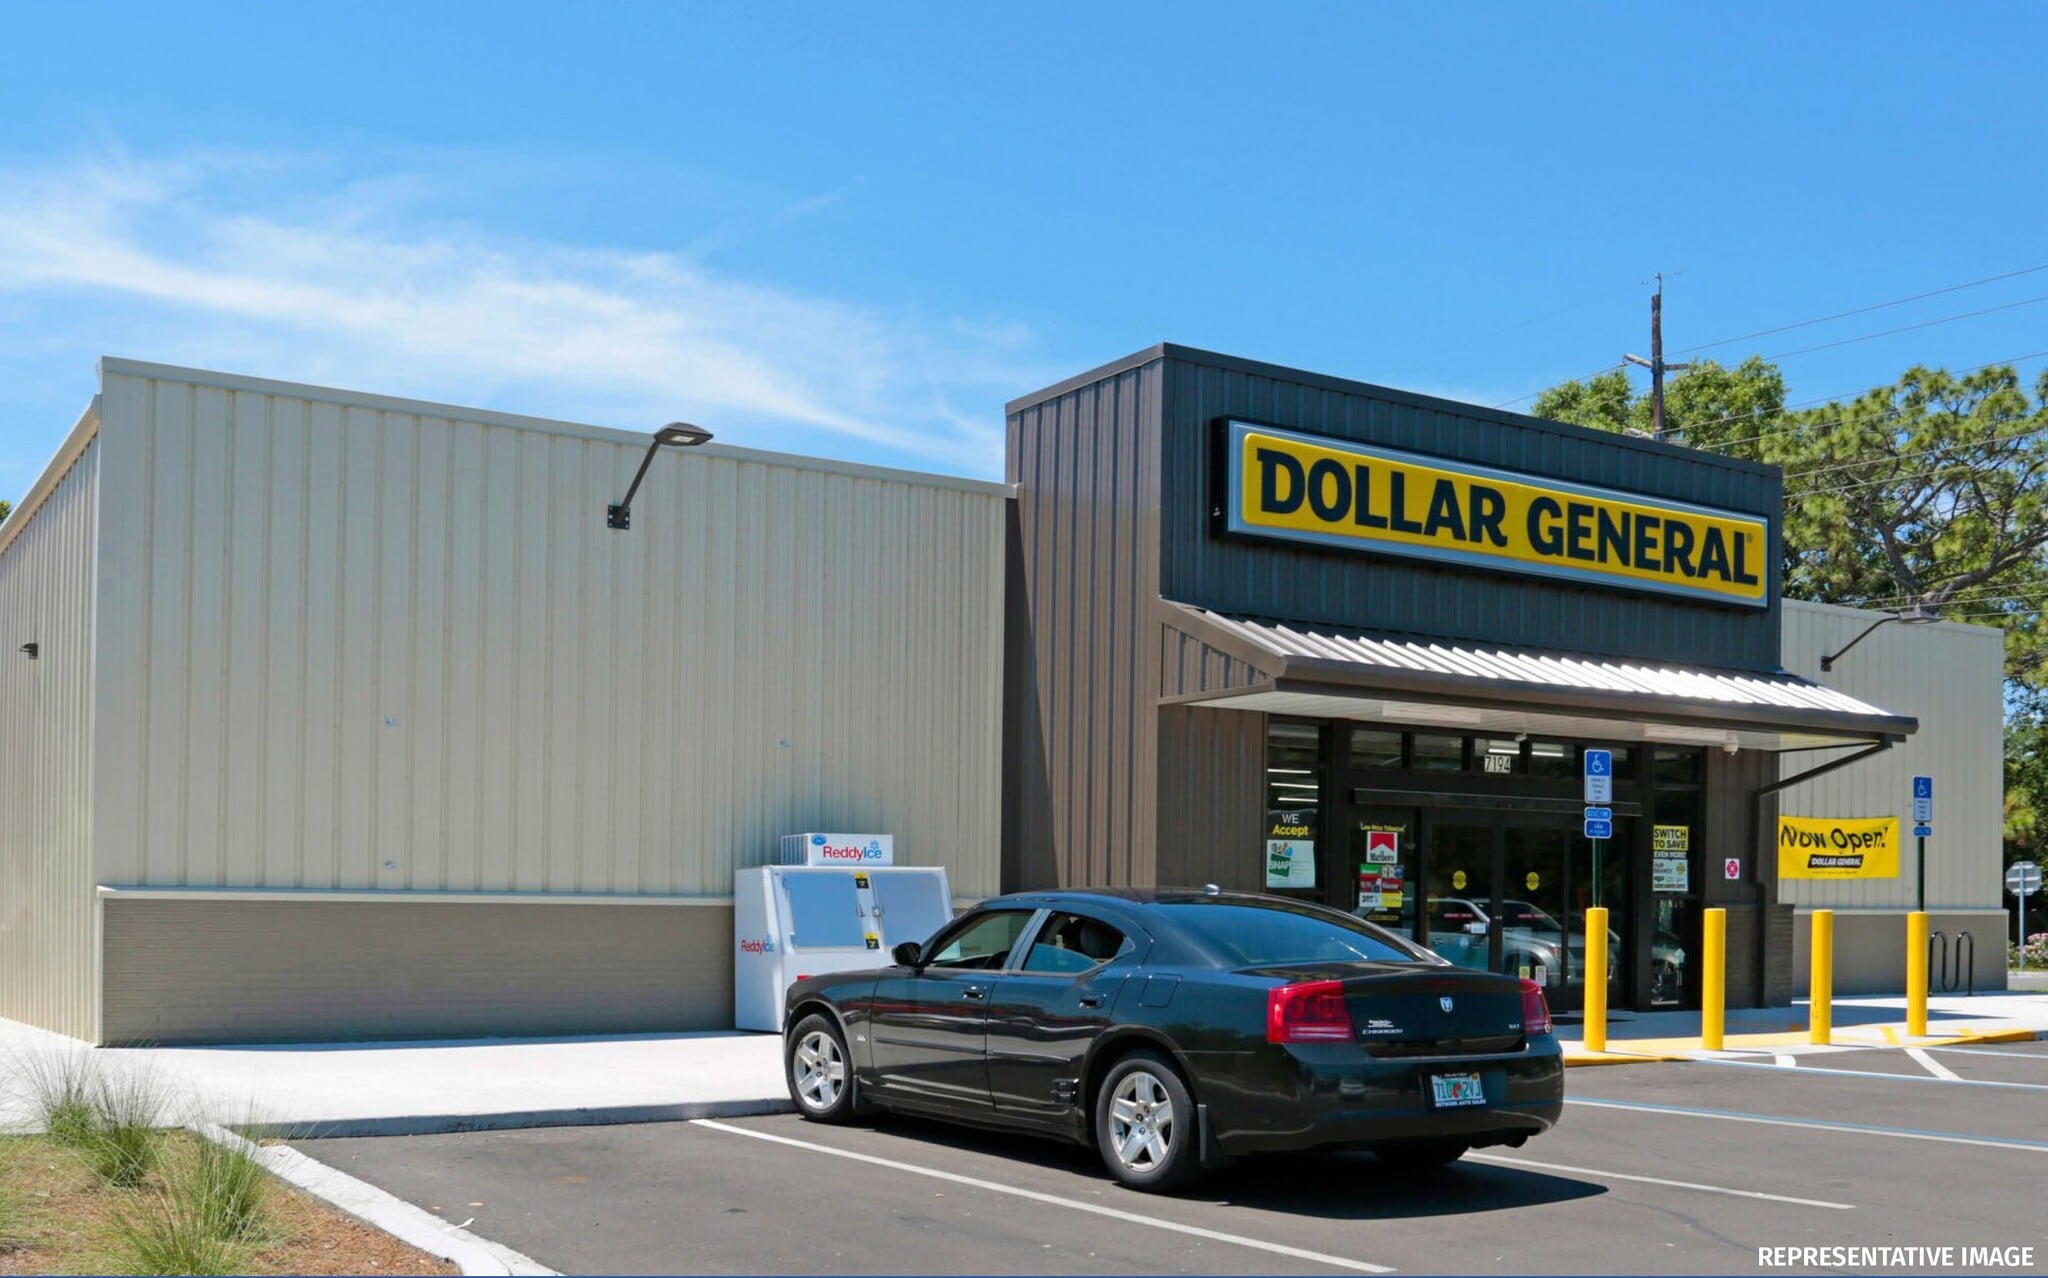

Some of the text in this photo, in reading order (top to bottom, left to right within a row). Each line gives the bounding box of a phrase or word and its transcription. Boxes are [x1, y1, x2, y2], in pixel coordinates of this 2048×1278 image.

[1256, 446, 1759, 587] DOLLAR GENERAL
[1485, 755, 1511, 771] 7194
[1282, 813, 1299, 824] WE
[1272, 824, 1310, 837] Accept
[1654, 828, 1686, 839] SWITCH
[1781, 825, 1826, 849] Now
[1654, 839, 1686, 849] TO SAVE
[1811, 856, 1836, 866] DOLLAR
